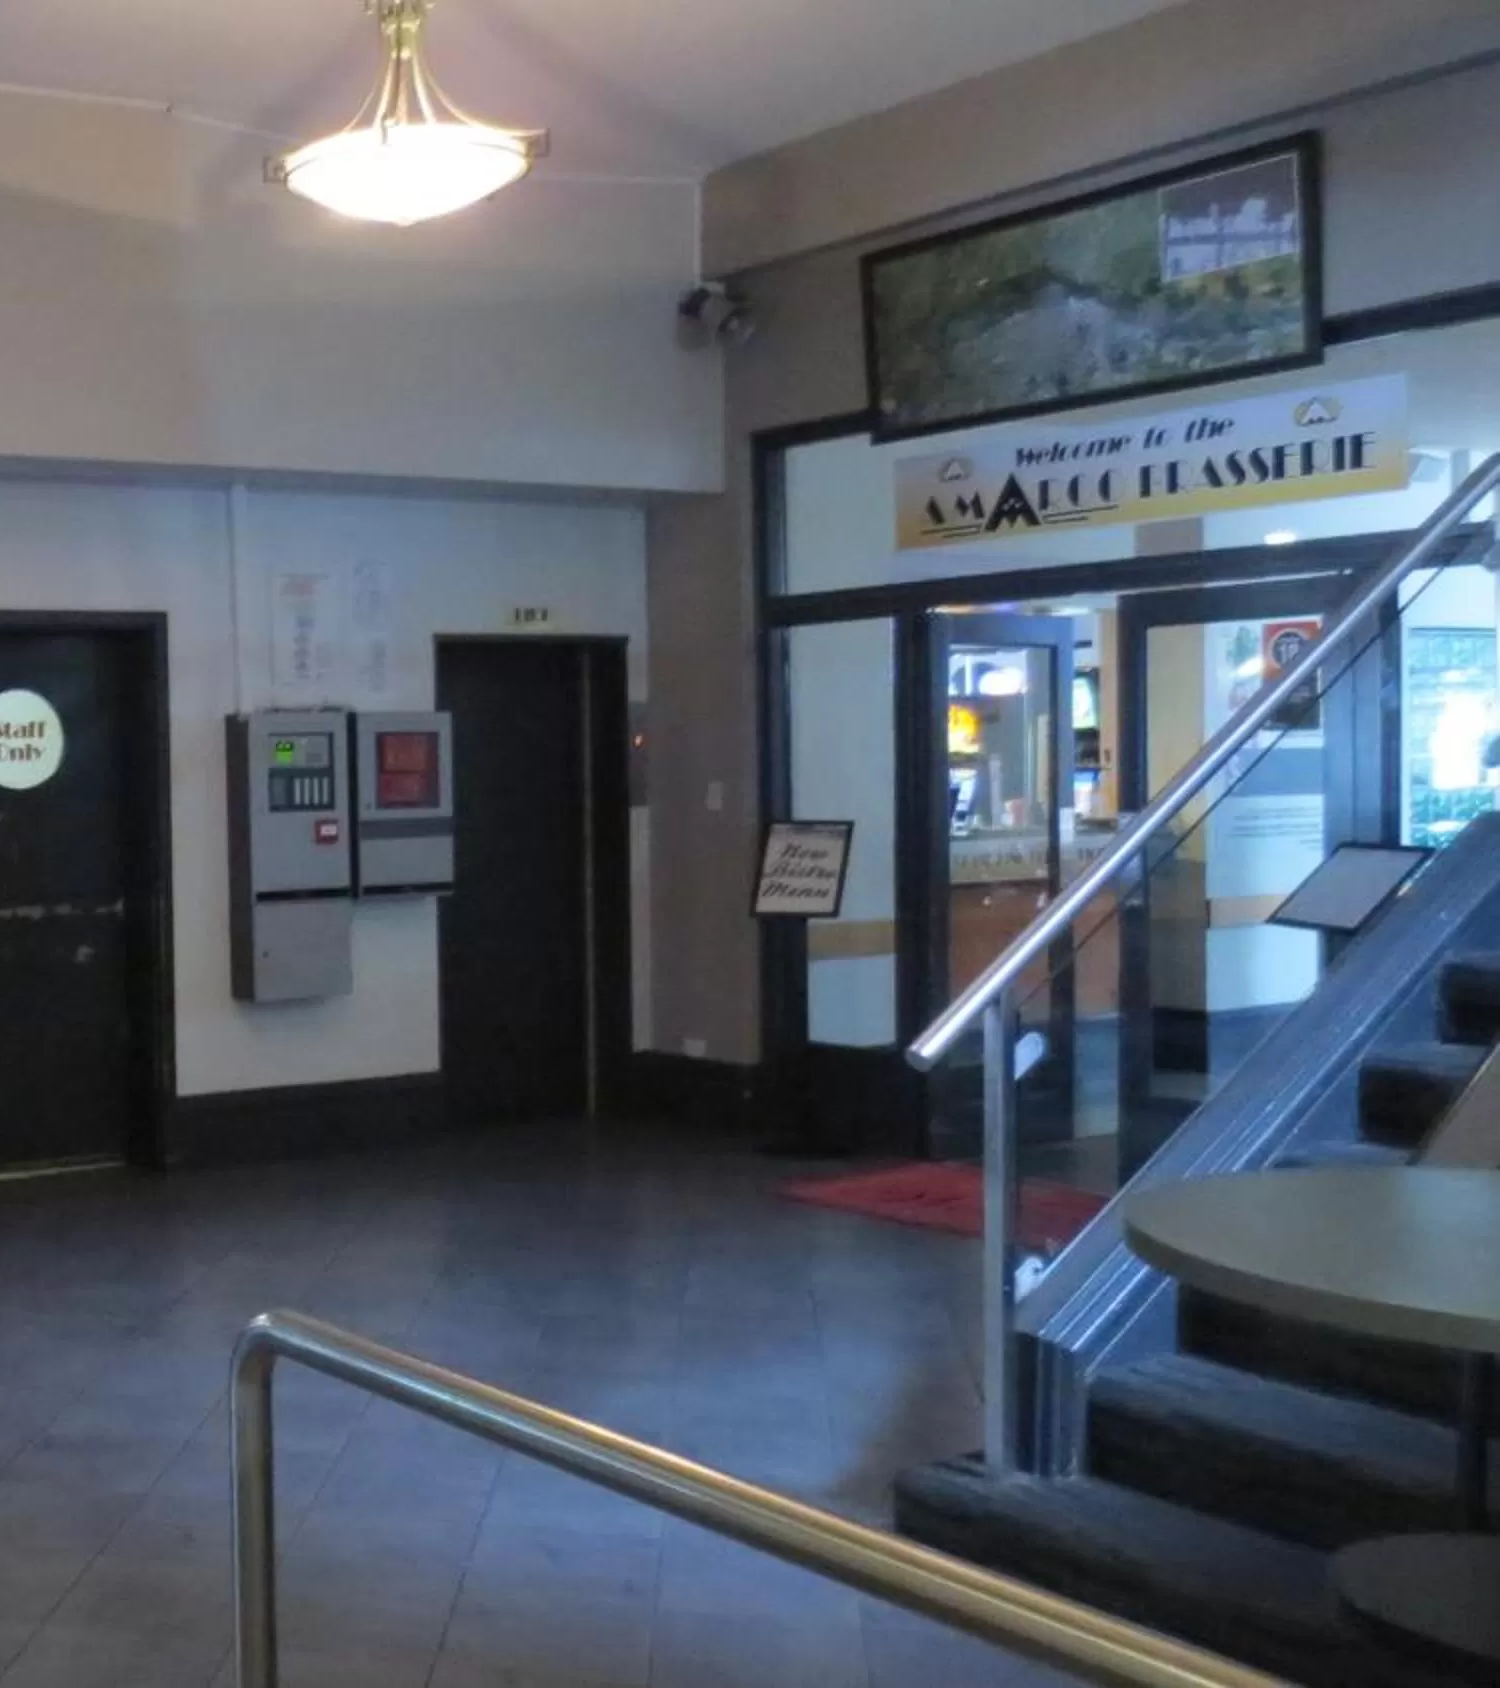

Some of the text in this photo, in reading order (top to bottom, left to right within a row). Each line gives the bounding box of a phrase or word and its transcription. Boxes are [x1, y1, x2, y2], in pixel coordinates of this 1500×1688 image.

[1015, 417, 1235, 467] Welcome to the
[1139, 431, 1376, 499] BRASSERIE
